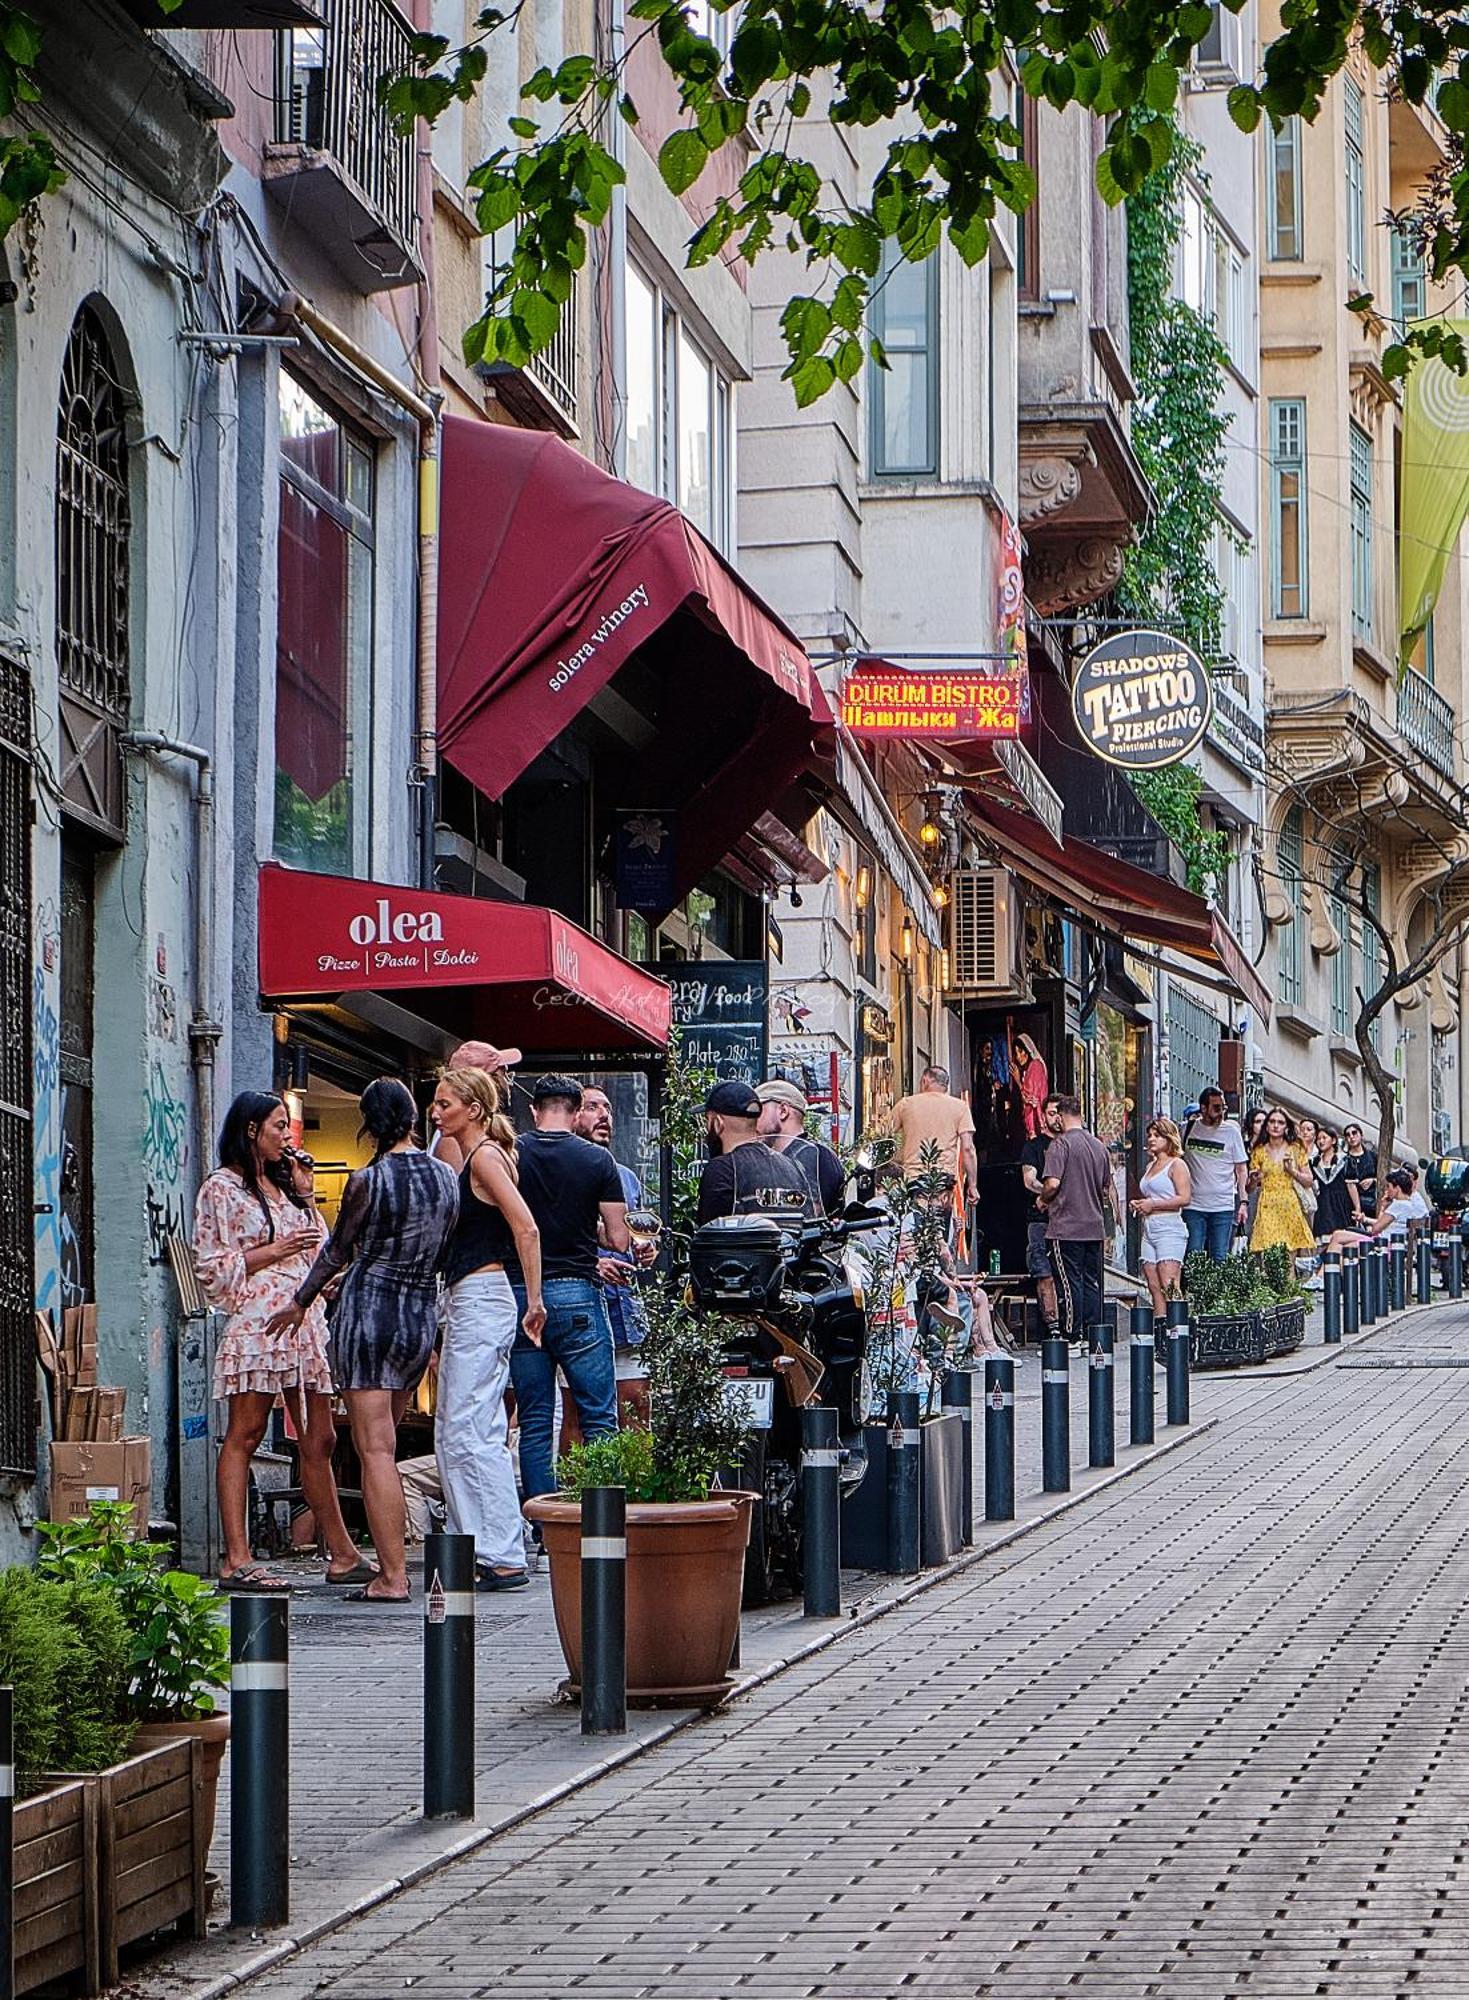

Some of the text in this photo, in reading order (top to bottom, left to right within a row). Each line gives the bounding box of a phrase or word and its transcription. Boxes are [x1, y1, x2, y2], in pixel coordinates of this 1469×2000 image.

[548, 583, 650, 692] solera winery
[1090, 652, 1190, 678] SHADOWS
[849, 680, 1010, 704] DÜRÜM BİSTRO
[1083, 669, 1197, 740] TATTOO
[842, 706, 957, 728] Шашлыки
[1112, 705, 1203, 743] PIERCING
[1108, 737, 1185, 755] Professional Studio
[348, 898, 445, 945] olea
[317, 948, 479, 972] Pizze Pasta Dolci
[556, 928, 579, 983] olea
[688, 1040, 722, 1063] Plate
